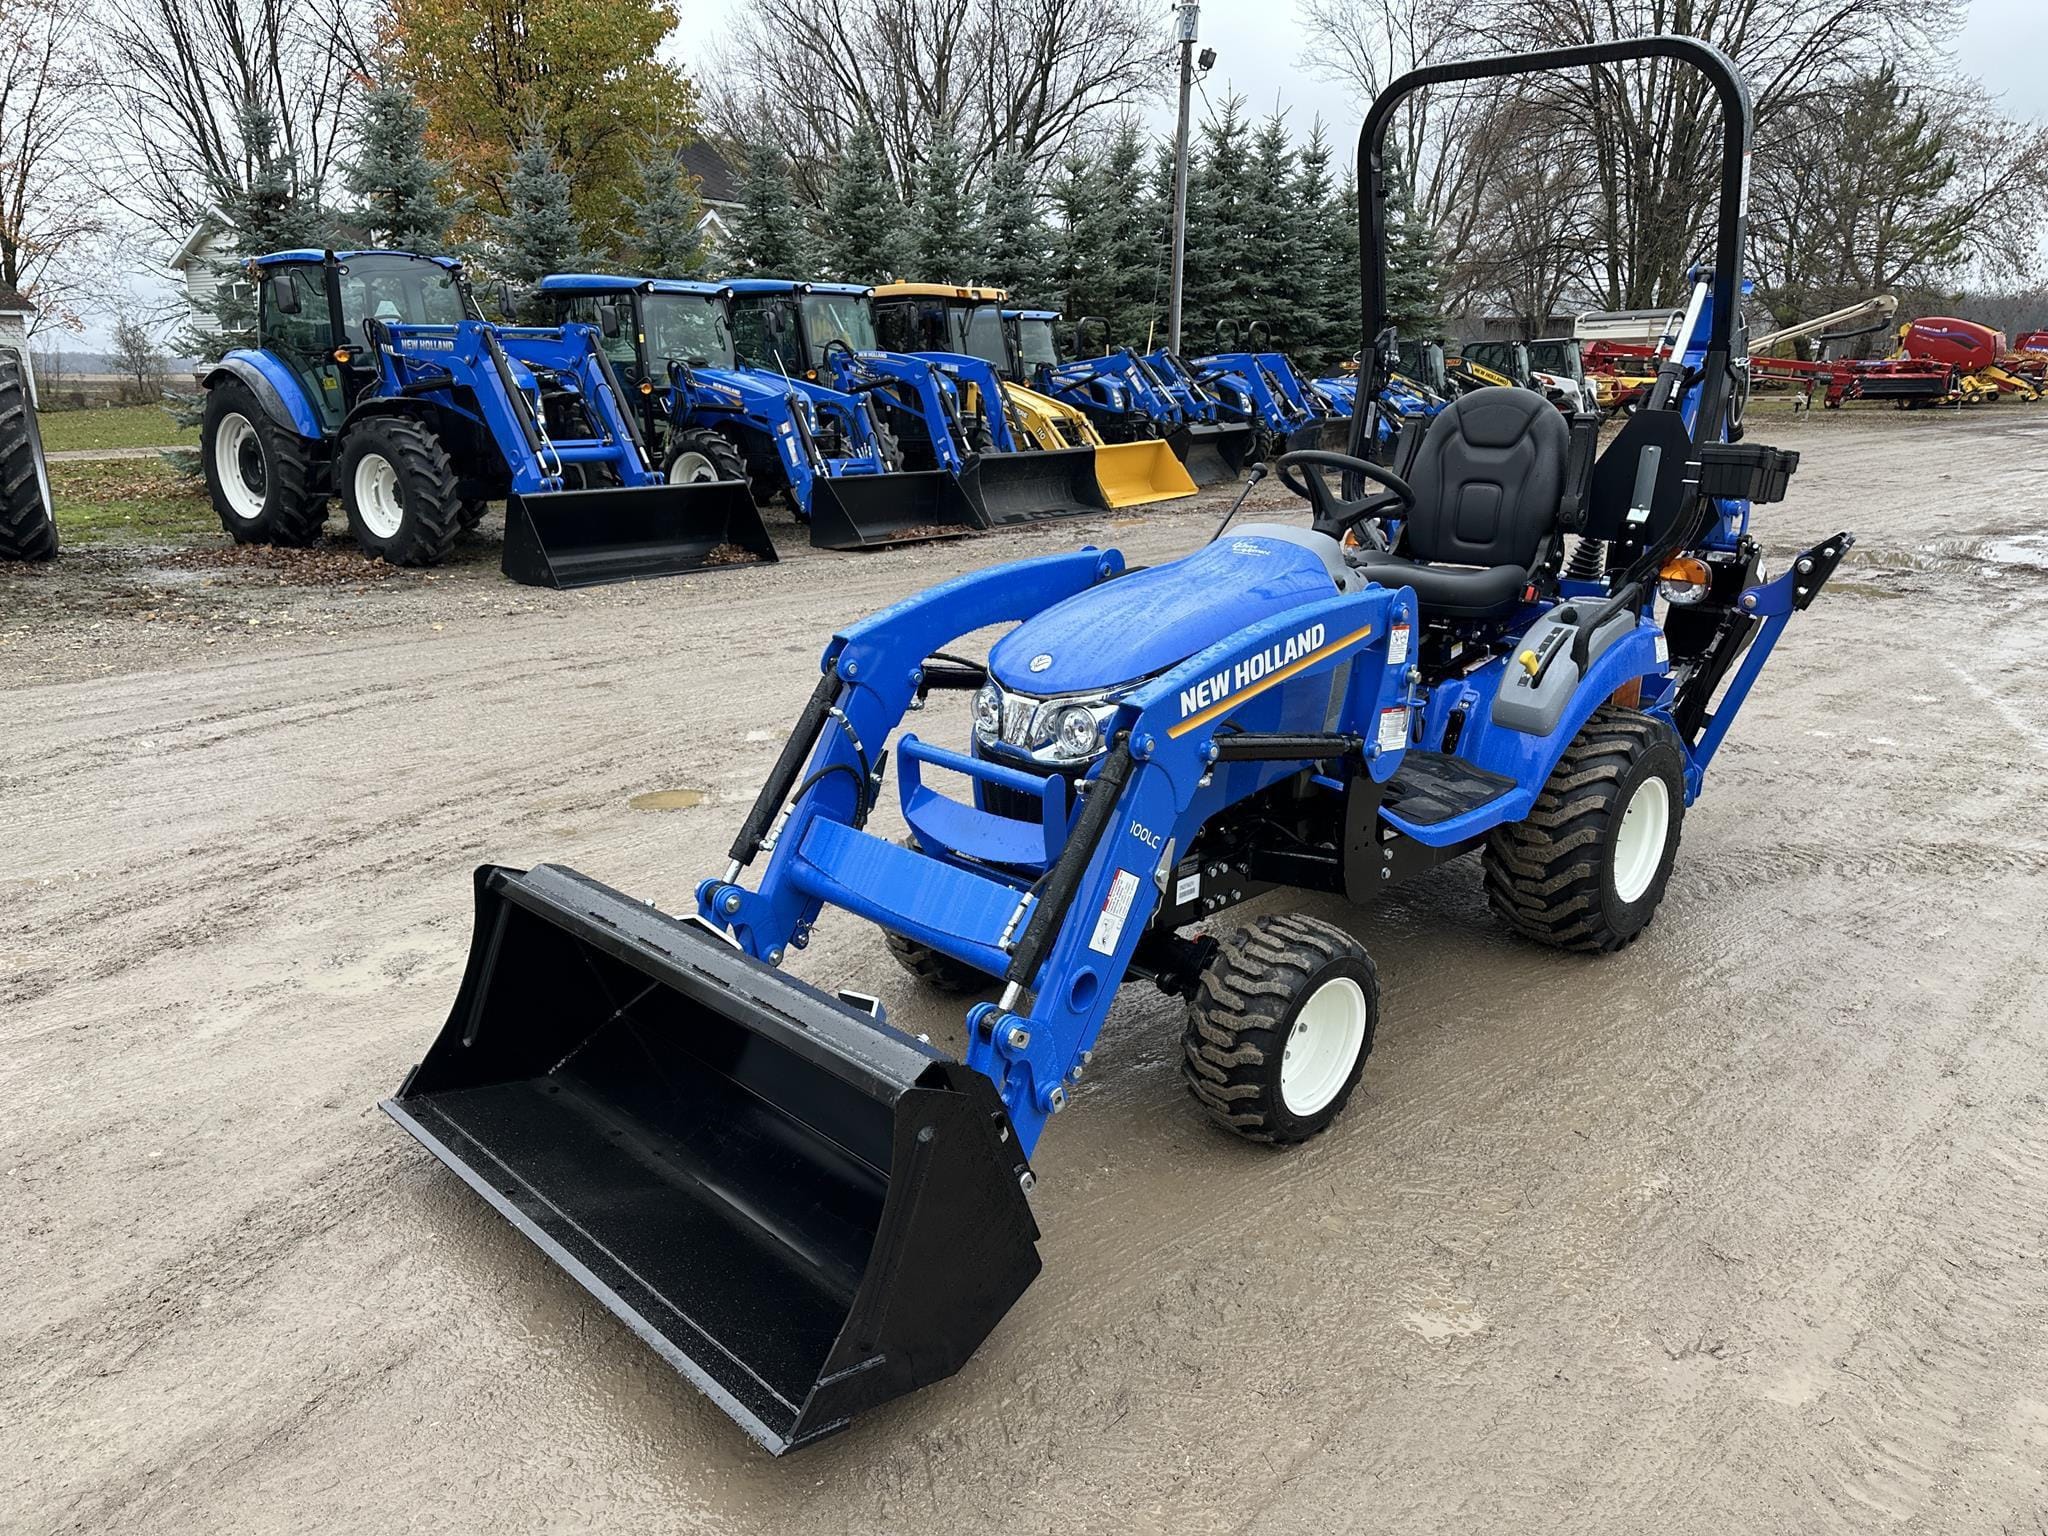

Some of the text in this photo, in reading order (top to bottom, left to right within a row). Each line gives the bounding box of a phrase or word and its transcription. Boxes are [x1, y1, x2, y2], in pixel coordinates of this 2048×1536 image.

[401, 339, 454, 352] NEW HOLLAND
[1036, 427, 1047, 441] 110
[1180, 669, 1231, 718] NEW
[1234, 623, 1325, 690] HOLLAND
[1129, 820, 1161, 850] 100LC
